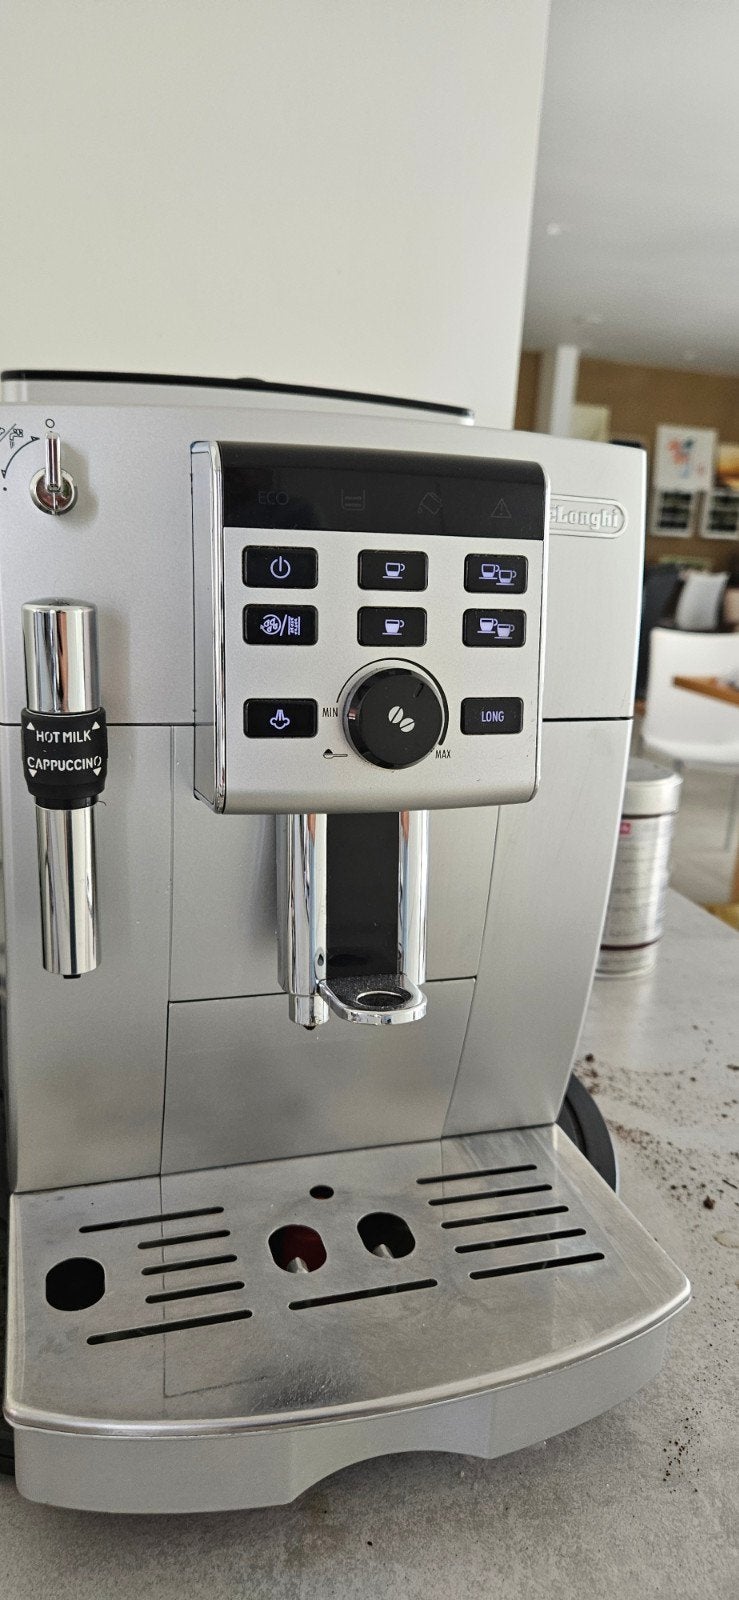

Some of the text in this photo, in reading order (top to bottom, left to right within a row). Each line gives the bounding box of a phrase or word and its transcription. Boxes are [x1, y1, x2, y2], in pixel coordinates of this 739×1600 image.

[258, 491, 289, 505] ECO
[322, 707, 338, 717] MIN
[481, 710, 505, 722] LONG
[36, 730, 91, 743] HOT MILK
[435, 749, 451, 759] MAX
[27, 756, 102, 771] CAPPUCCINO
